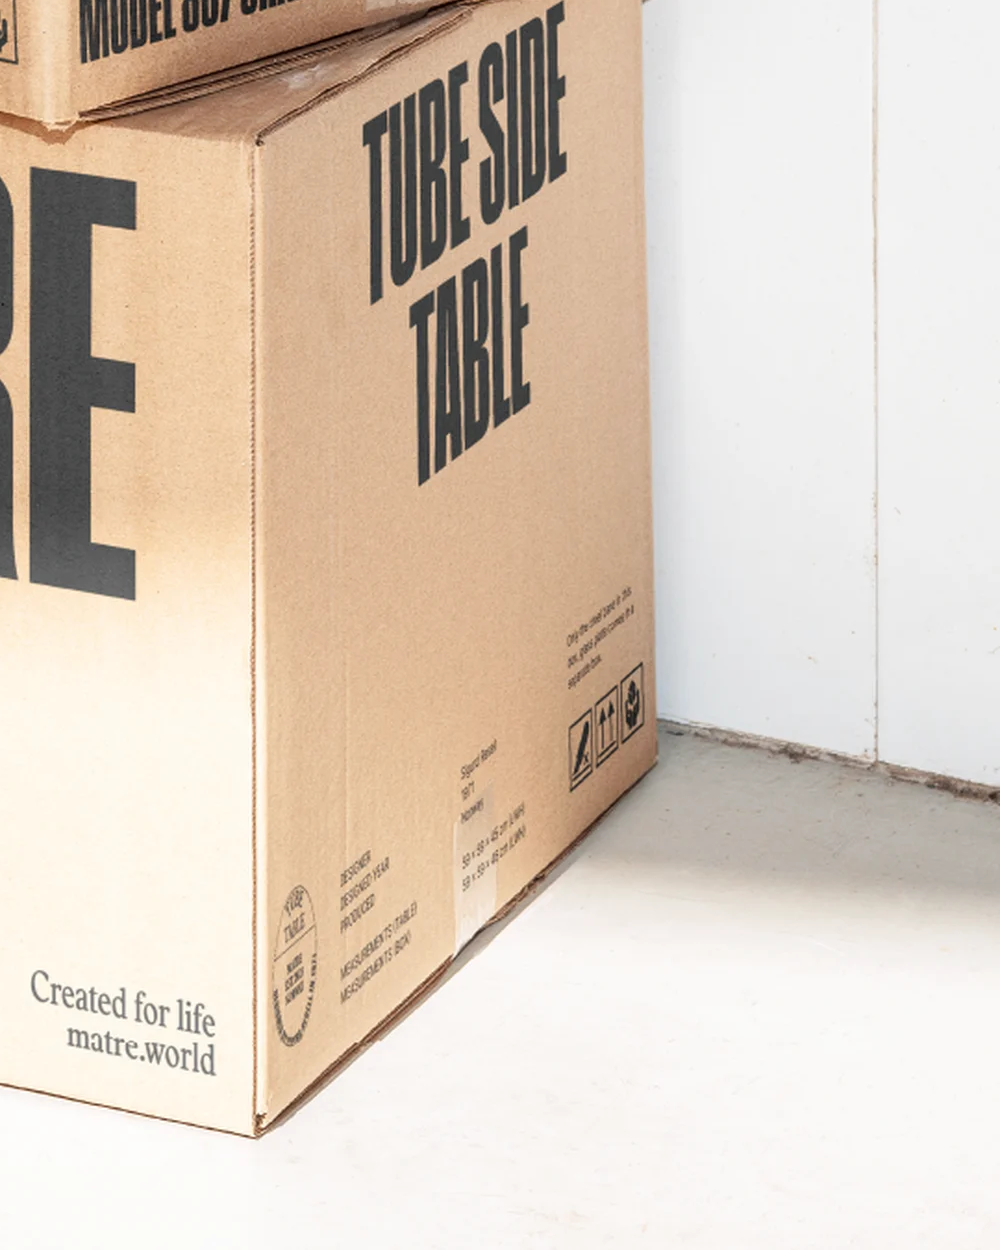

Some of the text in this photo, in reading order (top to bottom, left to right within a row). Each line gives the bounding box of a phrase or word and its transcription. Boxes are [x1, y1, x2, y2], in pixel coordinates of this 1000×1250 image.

[362, 0, 567, 307] TUBE SIDE
[409, 225, 531, 488] TABLE
[340, 849, 371, 888] DESIGNER
[340, 856, 390, 912] DESIGNED YEAR
[340, 893, 376, 935] PRODUCED
[340, 923, 393, 981] MEASUREMENTS
[393, 900, 418, 934] (TABLE)
[30, 969, 216, 1038] Created for life
[340, 948, 393, 1005] MEASUREMENTS
[66, 1026, 217, 1077] matre.world
